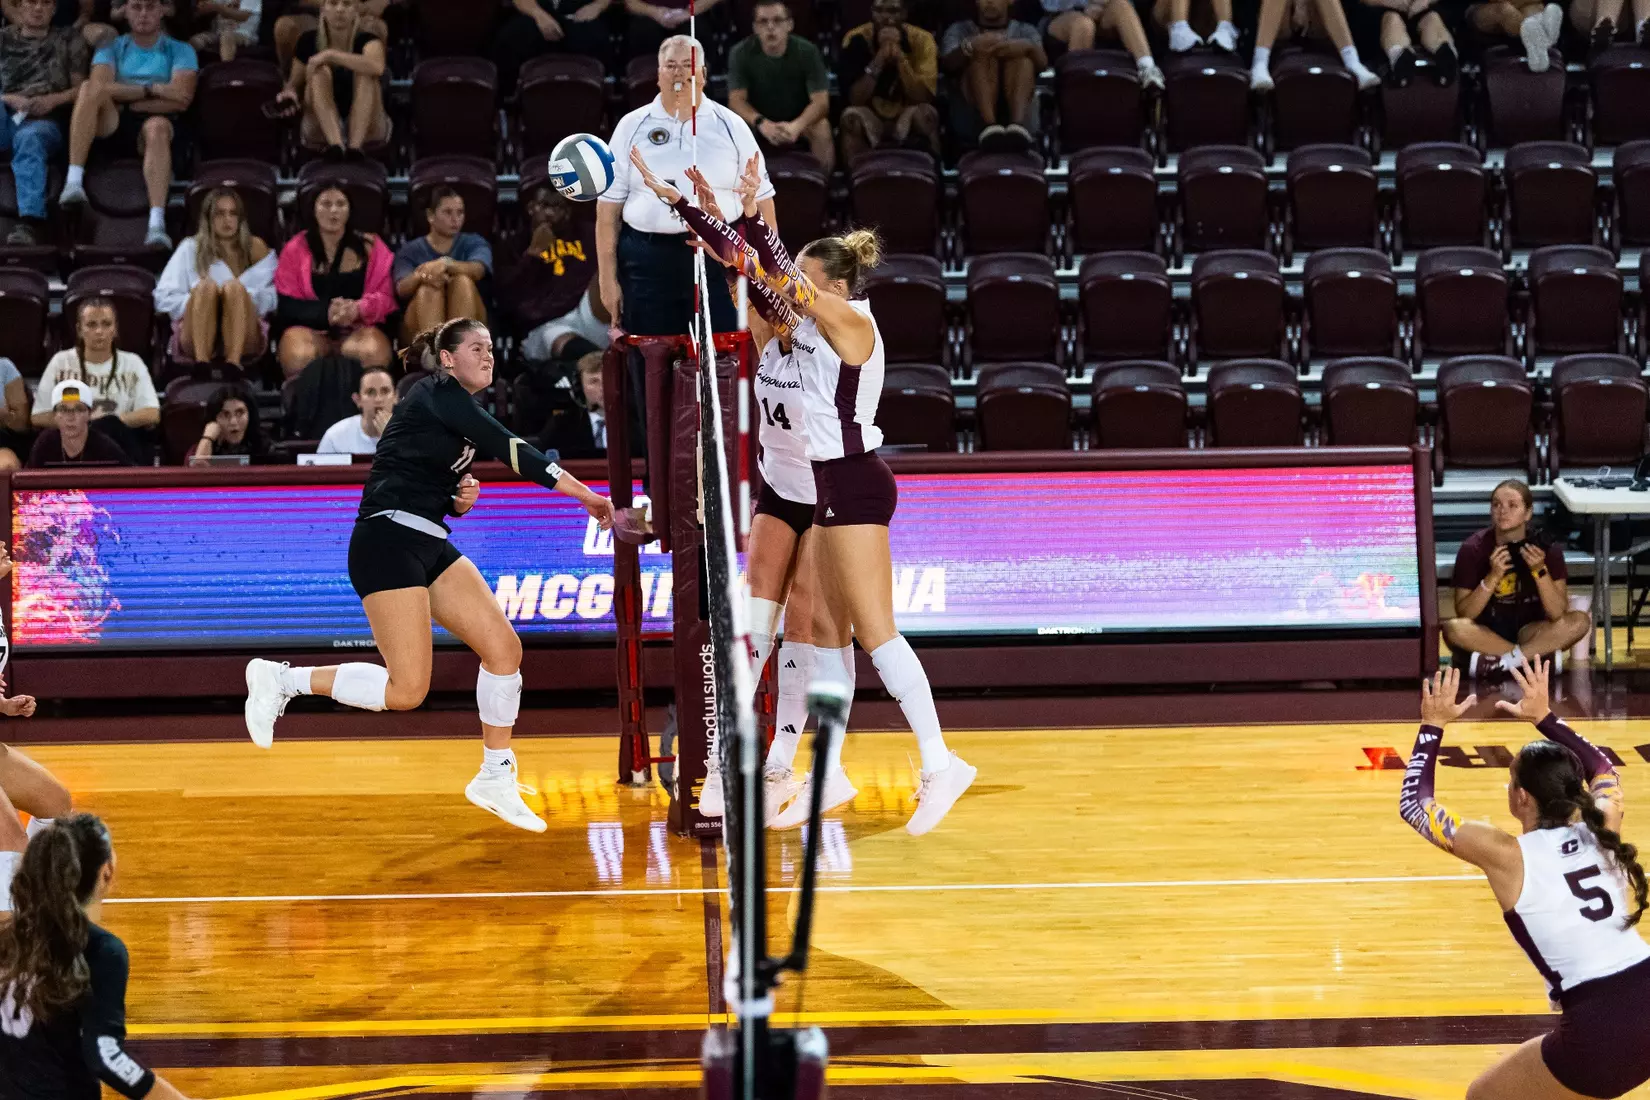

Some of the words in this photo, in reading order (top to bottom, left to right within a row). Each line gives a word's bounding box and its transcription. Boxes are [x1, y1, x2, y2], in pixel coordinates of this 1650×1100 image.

[764, 227, 803, 282] CHIPPEWAS
[761, 397, 792, 430] 14
[450, 445, 476, 474] 11
[1563, 864, 1615, 922] 5
